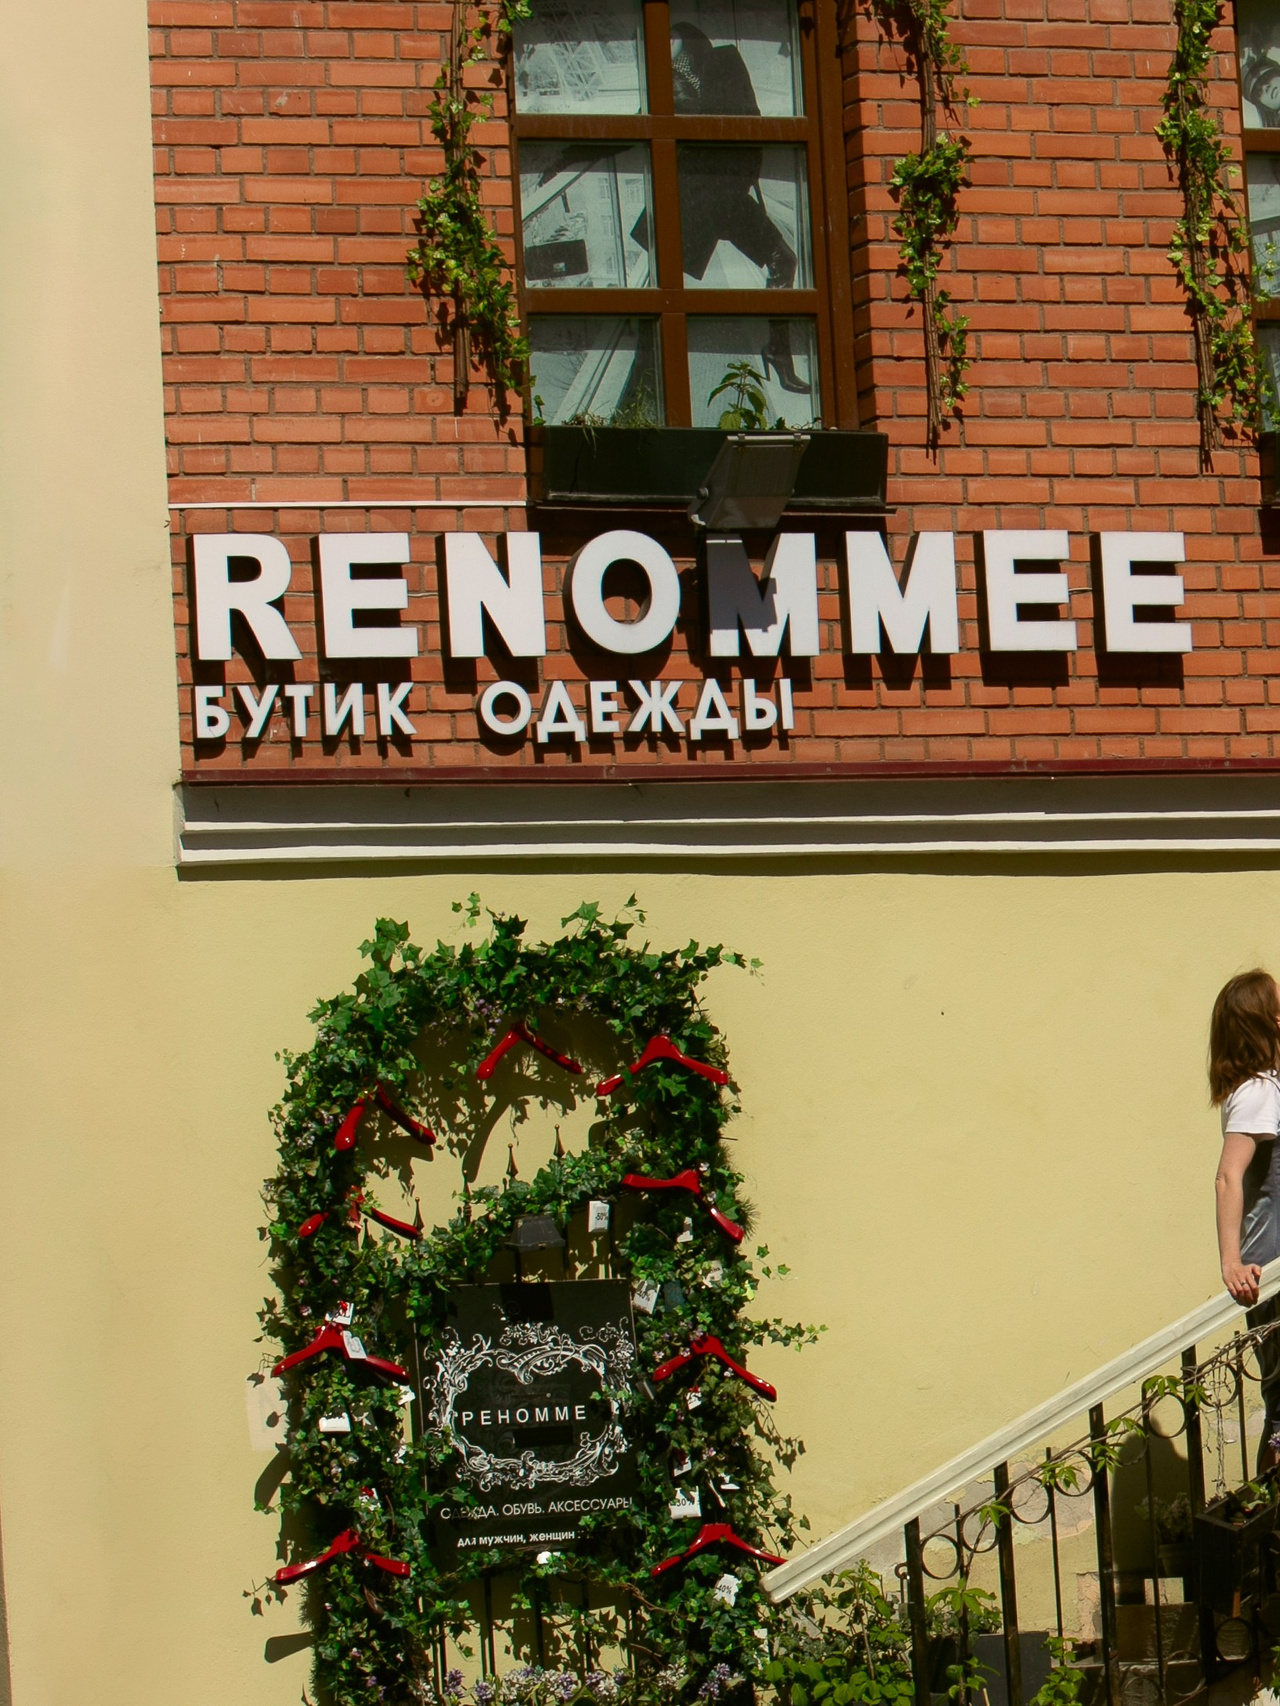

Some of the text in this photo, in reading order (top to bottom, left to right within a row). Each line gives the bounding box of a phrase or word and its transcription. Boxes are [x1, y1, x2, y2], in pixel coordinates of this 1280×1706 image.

[193, 529, 1192, 660] RENOMMEE
[194, 678, 795, 743] БУТИК ОДЕЖДЫ
[461, 1404, 587, 1426] РЕНОММЕ
[548, 1497, 633, 1513] АКСЕССУАРЫ
[479, 1533, 526, 1547] мужчин,
[529, 1531, 576, 1542] женщин
